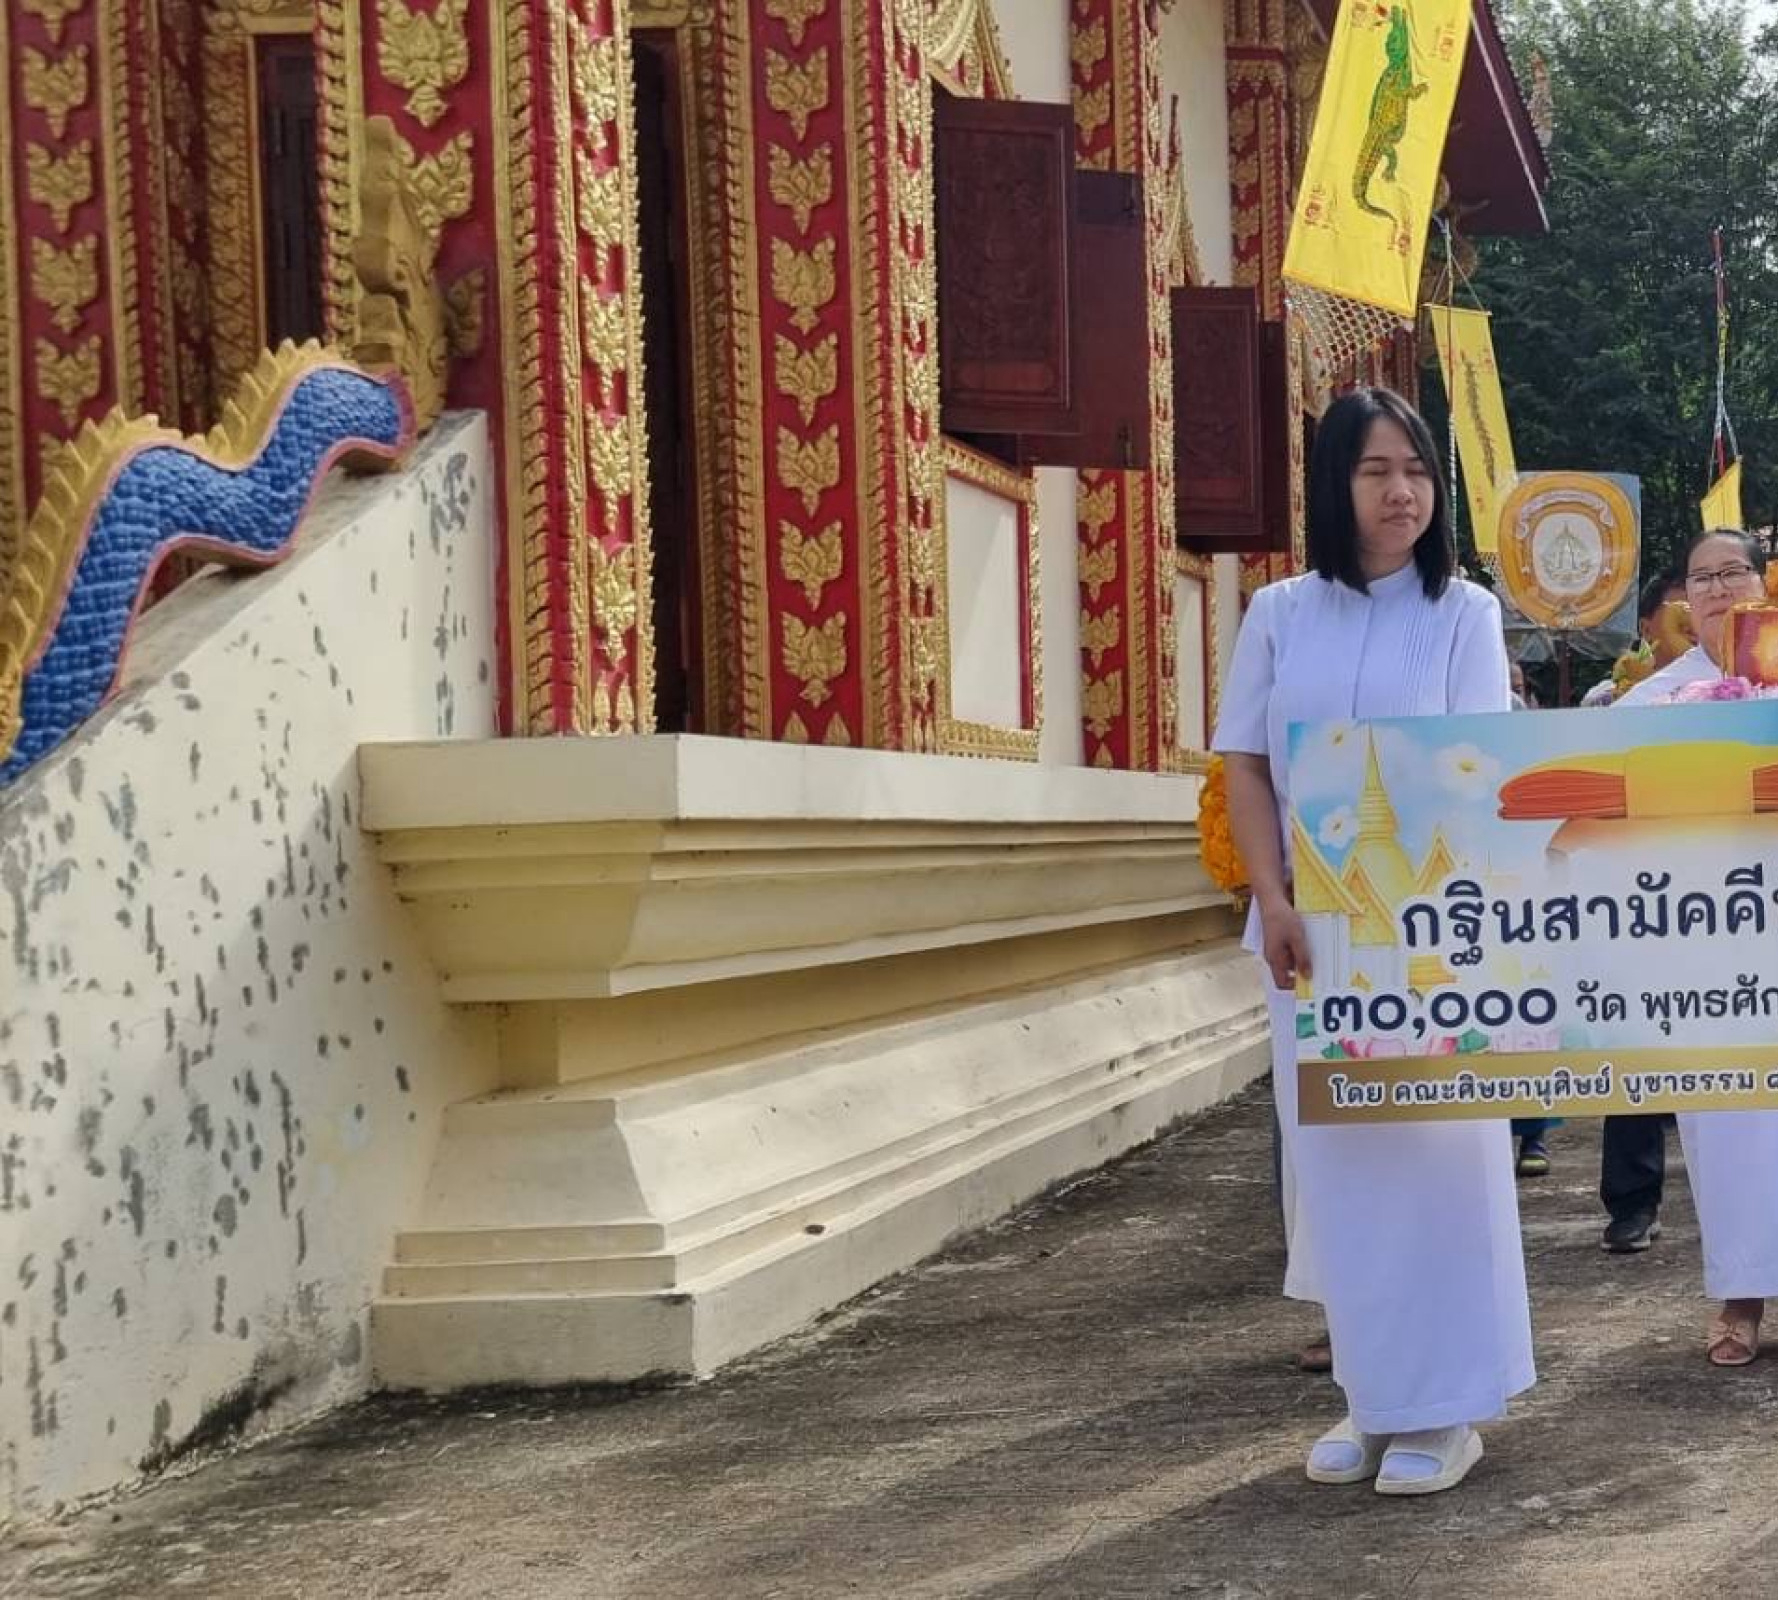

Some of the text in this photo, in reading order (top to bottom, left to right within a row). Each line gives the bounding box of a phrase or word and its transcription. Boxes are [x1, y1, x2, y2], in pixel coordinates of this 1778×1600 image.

[1322, 987, 1558, 1039] ๓๐,๐๐๐
[1575, 979, 1627, 1023] วัด
[1331, 1076, 1383, 1105] โดย
[1394, 1065, 1612, 1109] คณะศิษยานุศิษย์
[1623, 1067, 1754, 1104] บูชาธรรม
